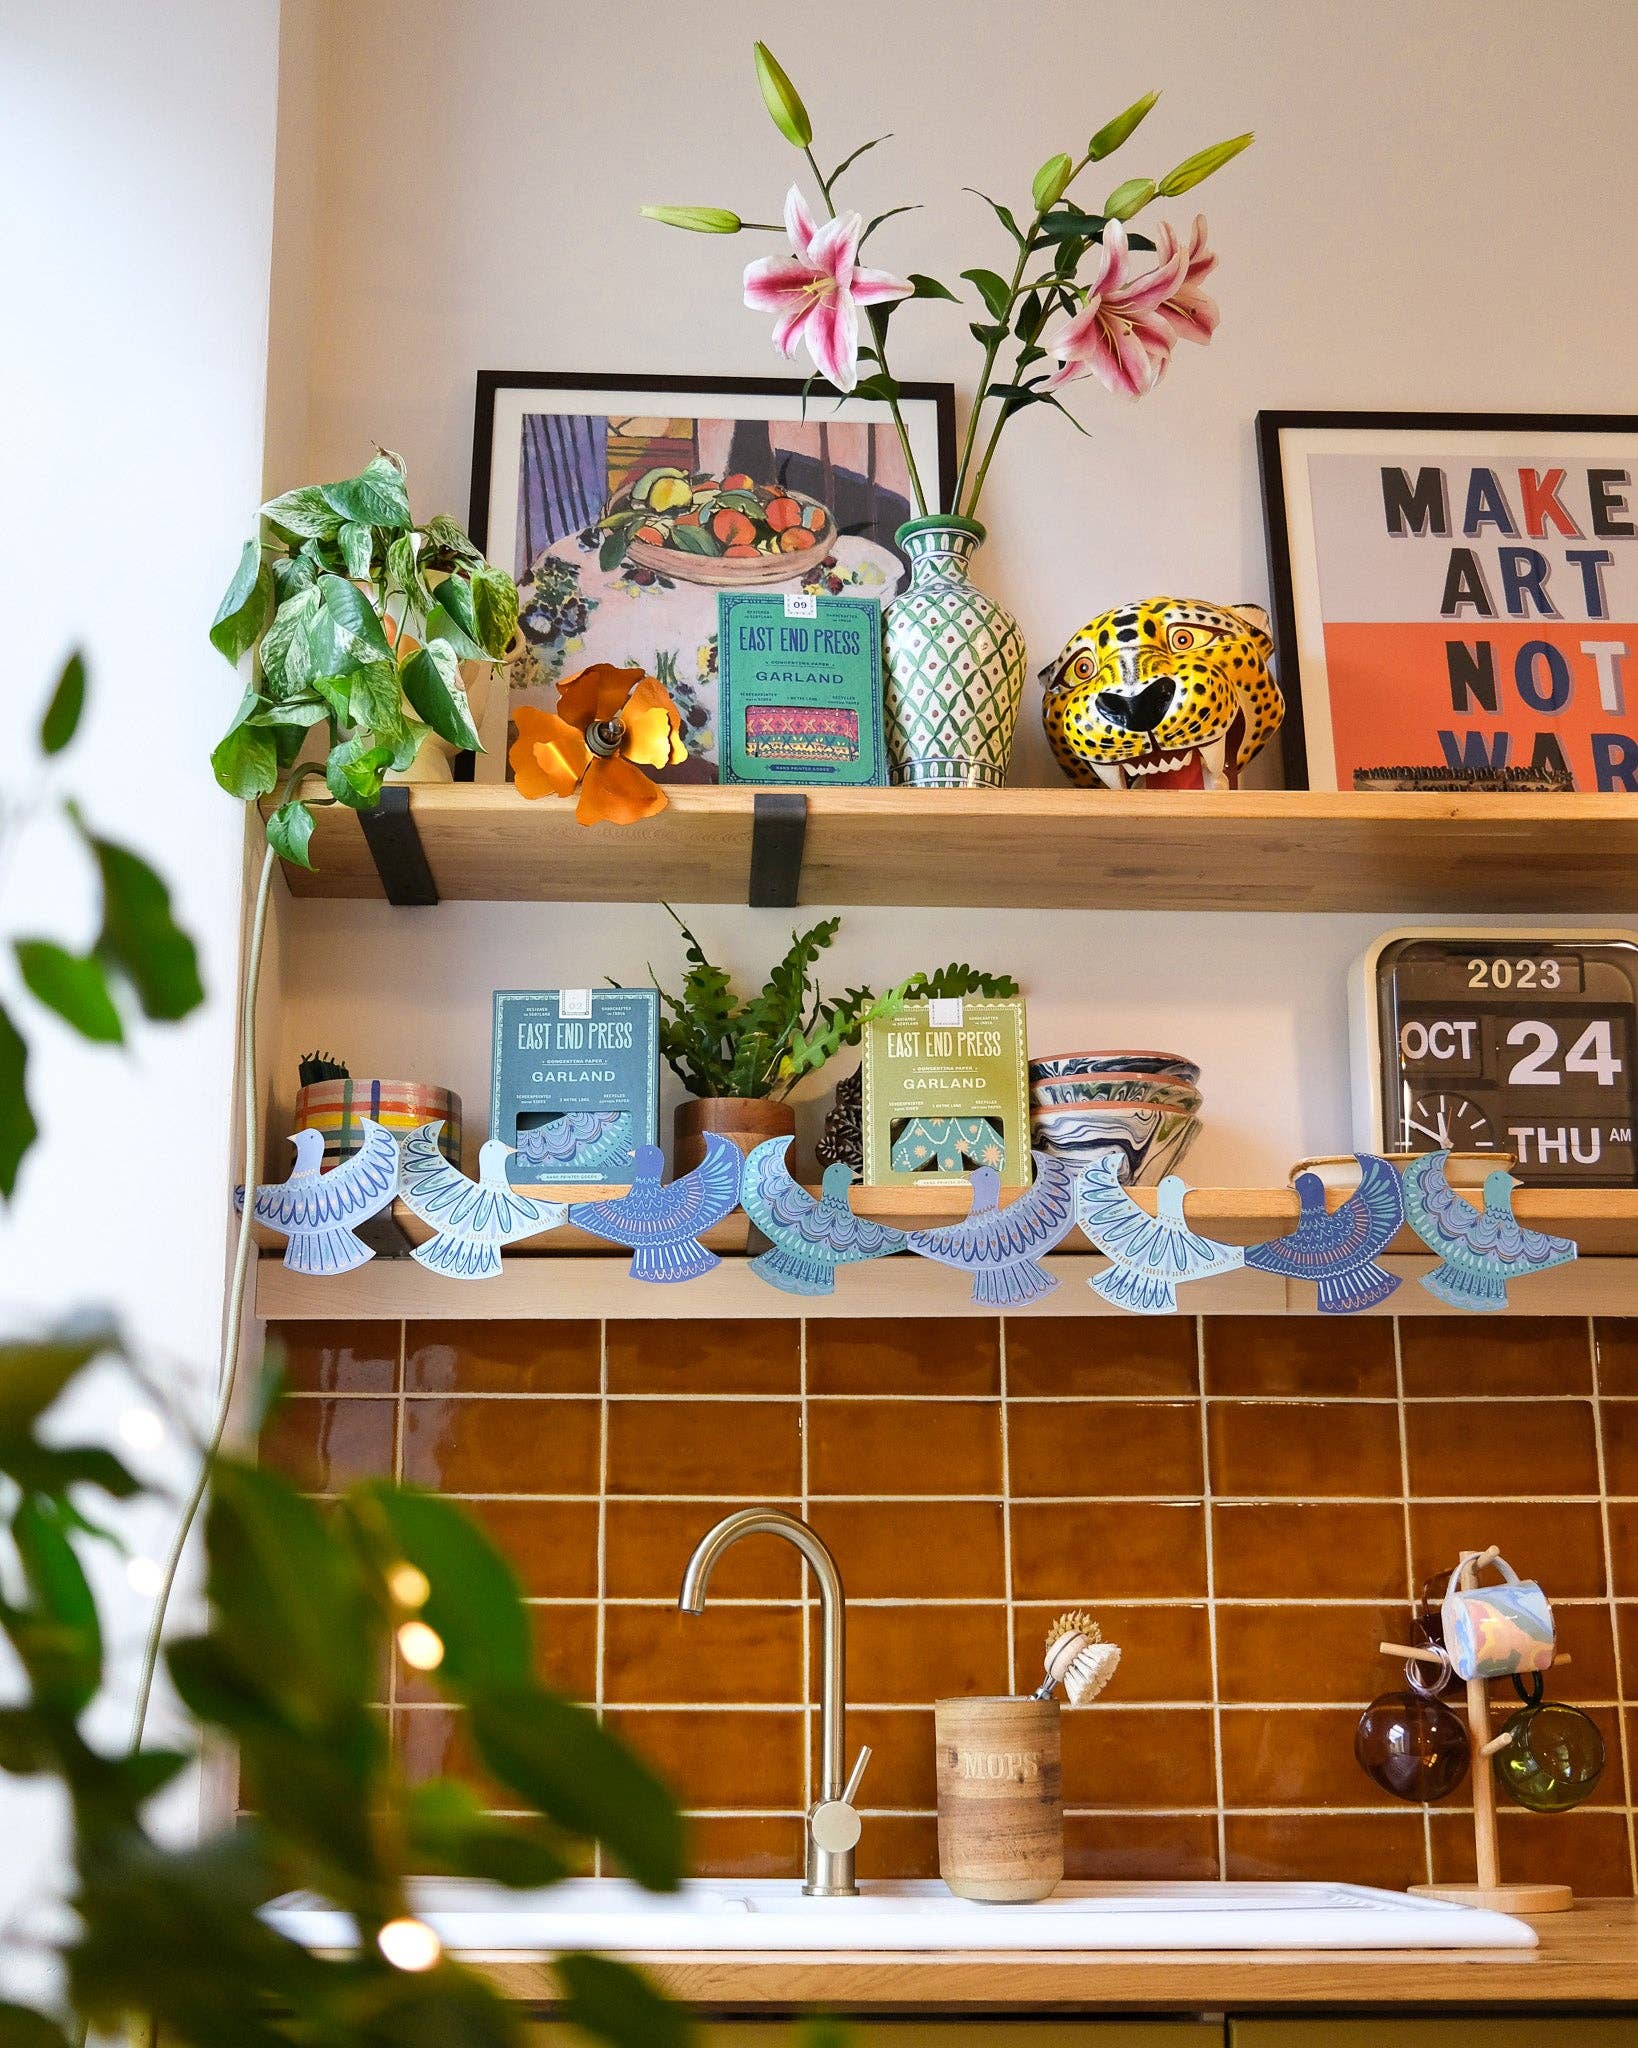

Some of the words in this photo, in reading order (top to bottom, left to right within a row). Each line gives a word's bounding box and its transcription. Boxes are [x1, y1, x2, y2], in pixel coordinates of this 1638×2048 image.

[1380, 467, 1638, 540] MAKE
[1440, 547, 1614, 619] ART
[740, 626, 774, 651] EAST
[781, 628, 808, 653] END
[814, 629, 860, 655] PRESS
[756, 672, 843, 684] GARLAND
[1446, 640, 1629, 716] NOT
[1468, 959, 1561, 989] 2023
[518, 1023, 552, 1049] EAST
[557, 1023, 584, 1049] END
[589, 1022, 633, 1049] PRESS
[888, 1032, 920, 1058] EAST
[926, 1032, 952, 1057] END
[957, 1031, 1000, 1057] PRESS
[1401, 1021, 1477, 1060] OCT
[1506, 1020, 1622, 1086] 24
[532, 1071, 615, 1082] GARLAND
[903, 1078, 986, 1090] GARLAND
[1508, 1127, 1600, 1164] THU
[1609, 1128, 1632, 1142] AM
